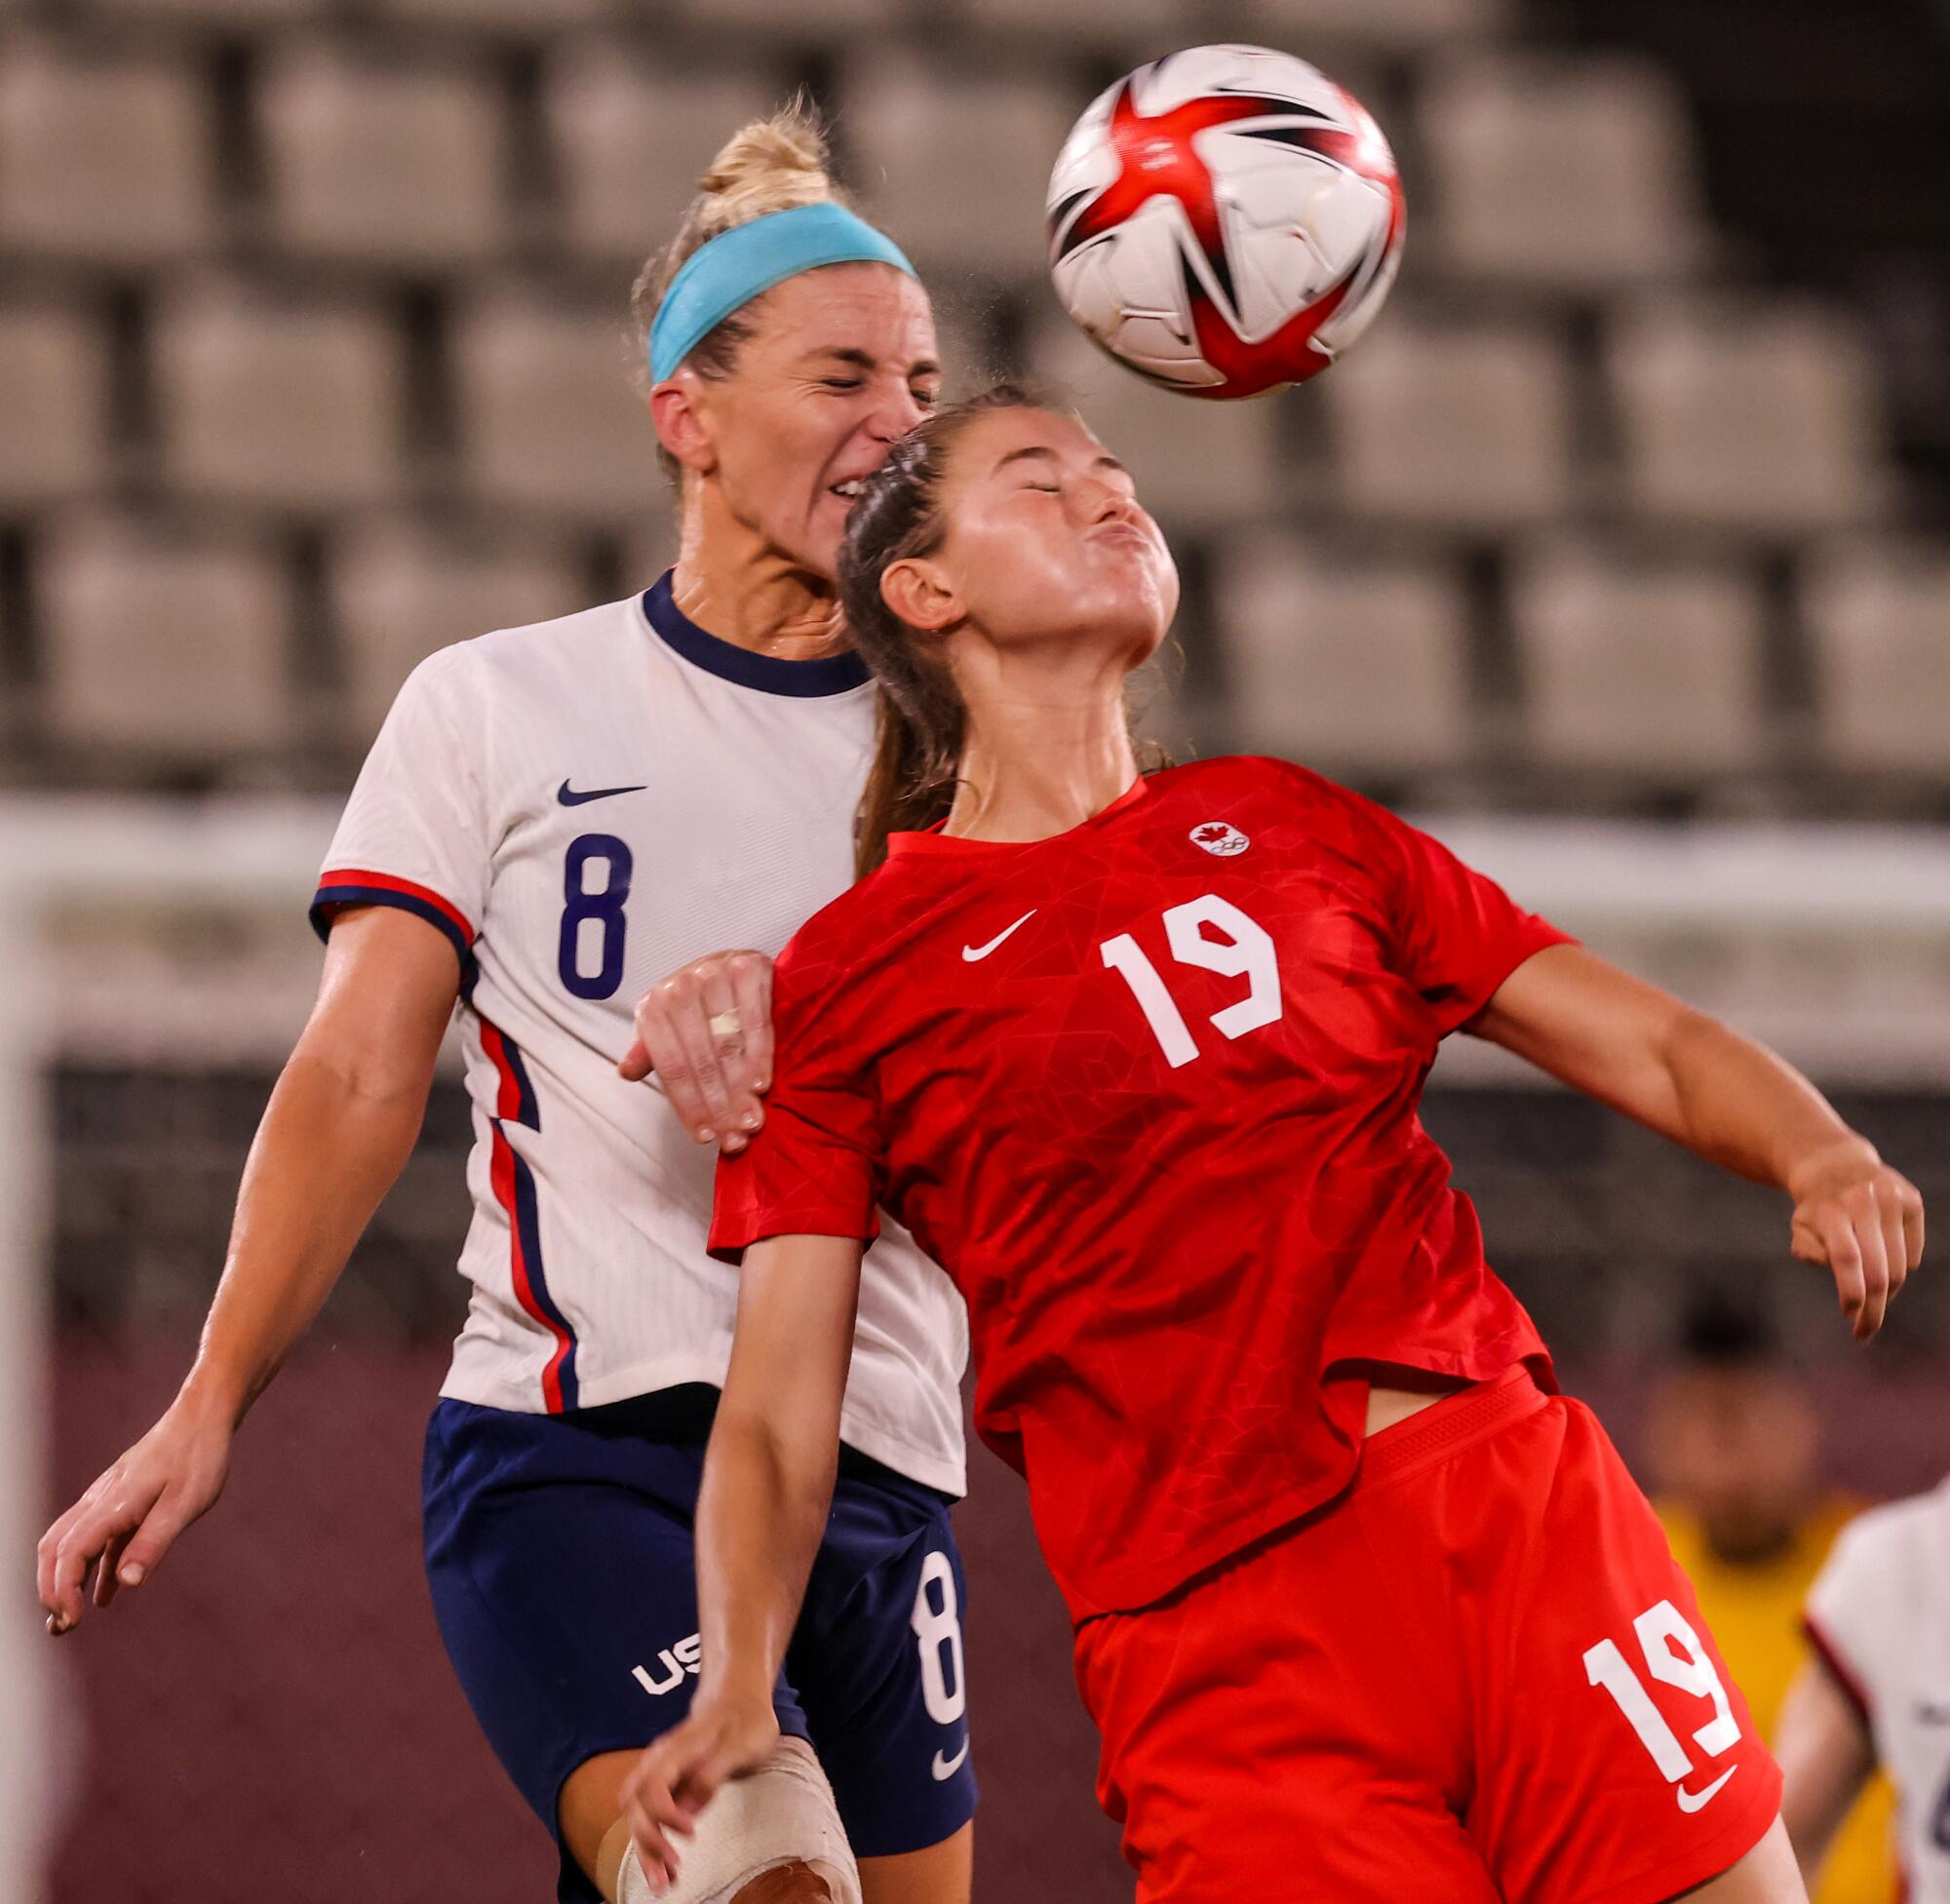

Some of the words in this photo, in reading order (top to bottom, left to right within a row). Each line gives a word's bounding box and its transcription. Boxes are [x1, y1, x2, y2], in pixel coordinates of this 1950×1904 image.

[559, 834, 633, 1000] 8
[1100, 894, 1282, 1069] 19
[911, 1551, 965, 1725] 8
[1582, 1600, 1741, 1783] 19
